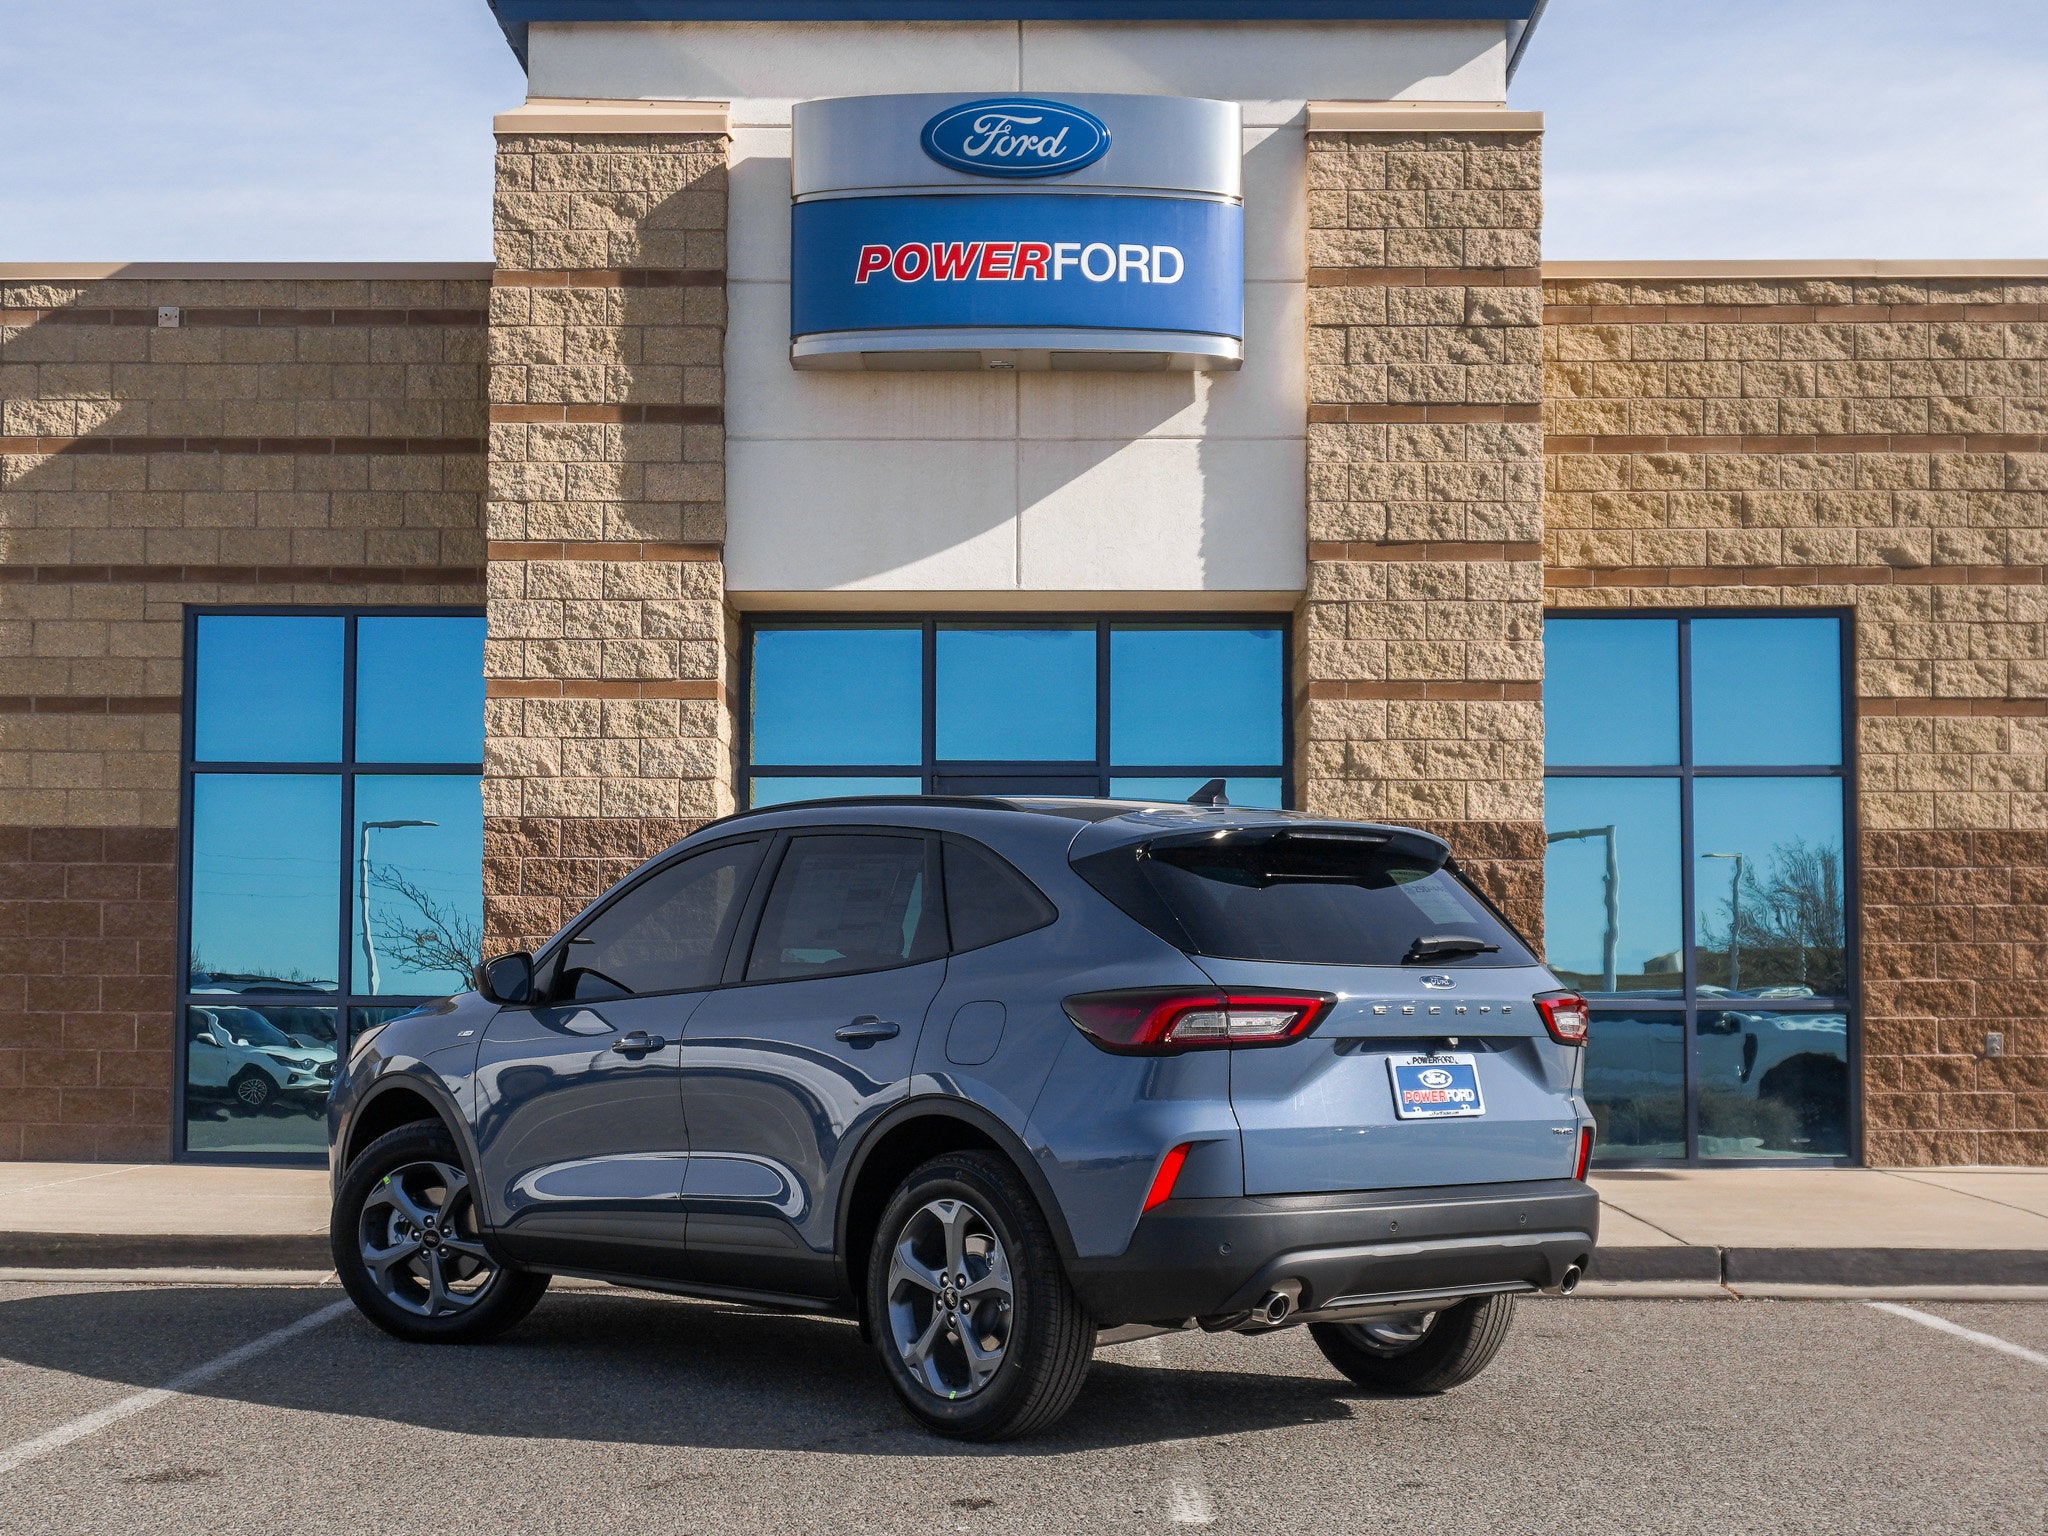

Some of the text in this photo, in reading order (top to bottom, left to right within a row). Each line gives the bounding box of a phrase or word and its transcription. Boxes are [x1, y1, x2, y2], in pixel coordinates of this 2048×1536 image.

[962, 113, 1070, 157] Ford
[854, 241, 1185, 285] POWERFORD
[1373, 1005, 1513, 1015] ESCAPE
[1412, 1055, 1455, 1065] POWERFORD
[1403, 1088, 1475, 1104] POWERFORD
